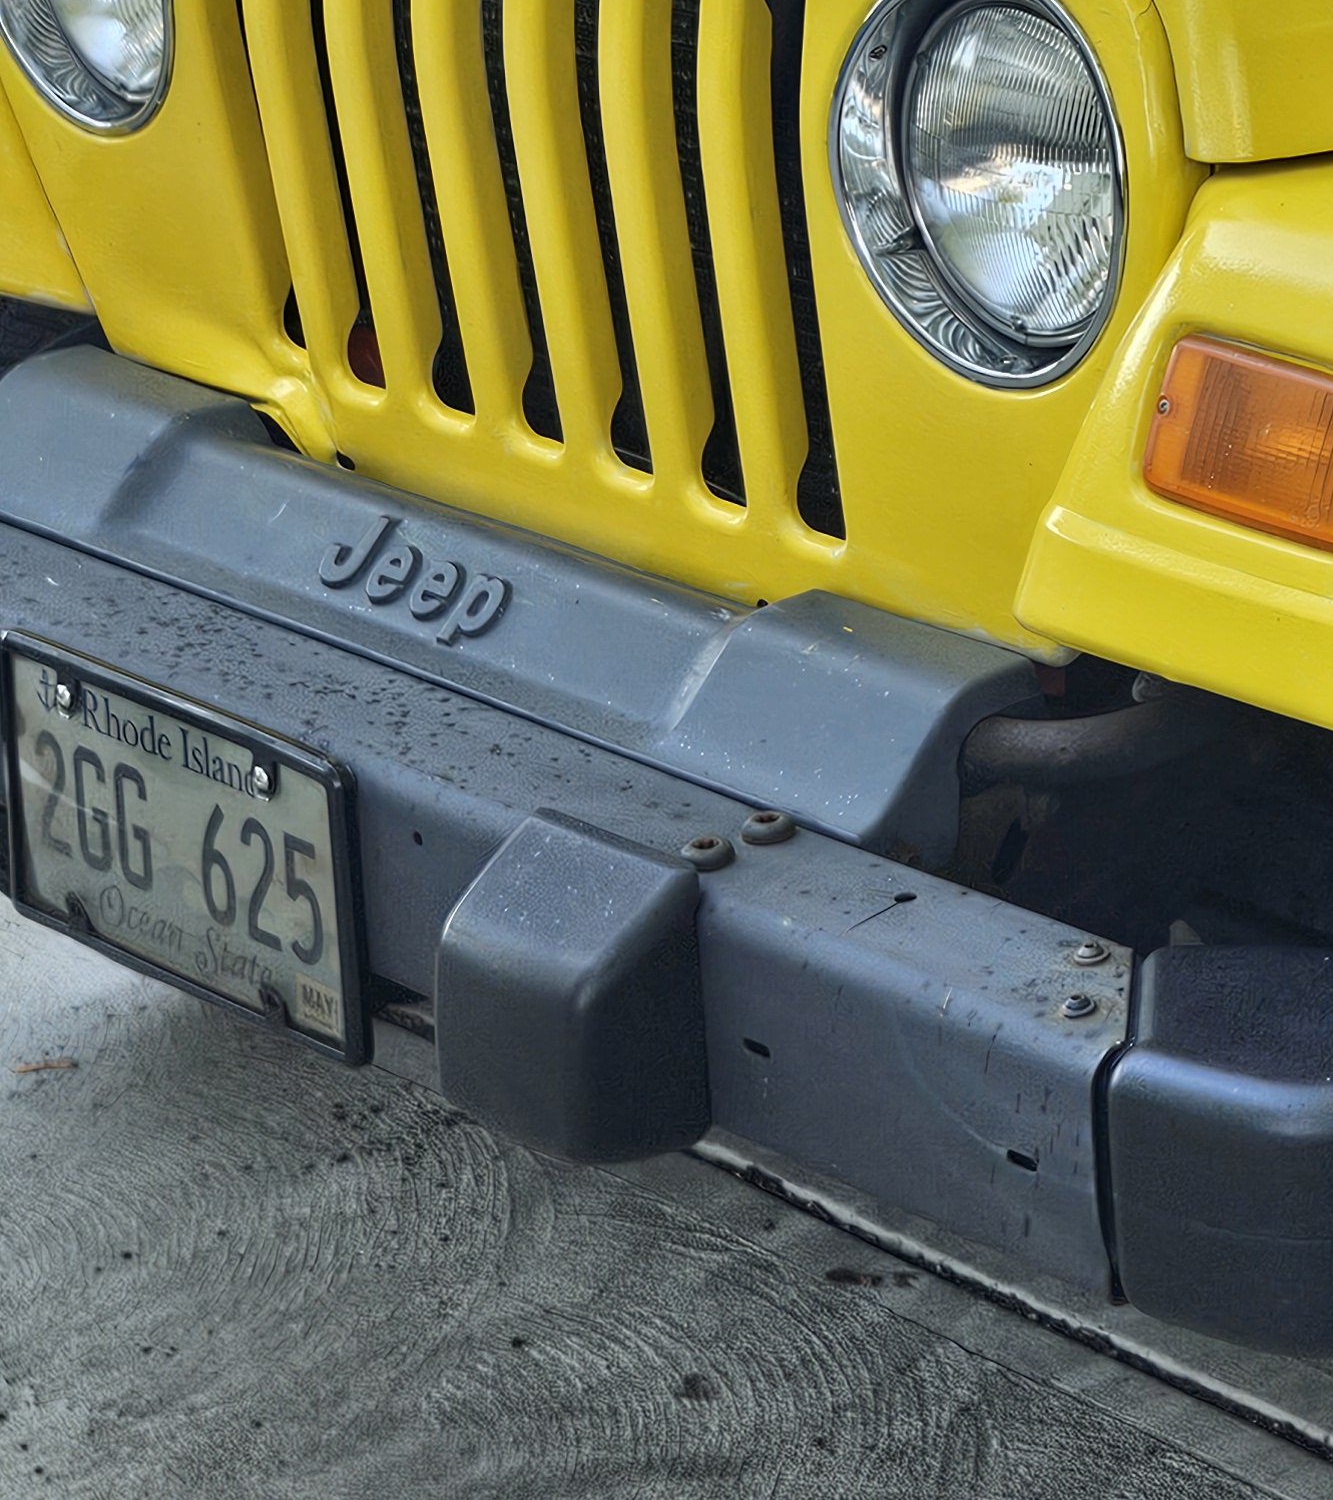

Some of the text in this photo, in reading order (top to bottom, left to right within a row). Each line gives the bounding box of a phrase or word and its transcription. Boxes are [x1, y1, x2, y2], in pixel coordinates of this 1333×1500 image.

[319, 515, 514, 647] Jeep
[80, 688, 173, 761] Rhode
[34, 729, 324, 966] 2GG 625
